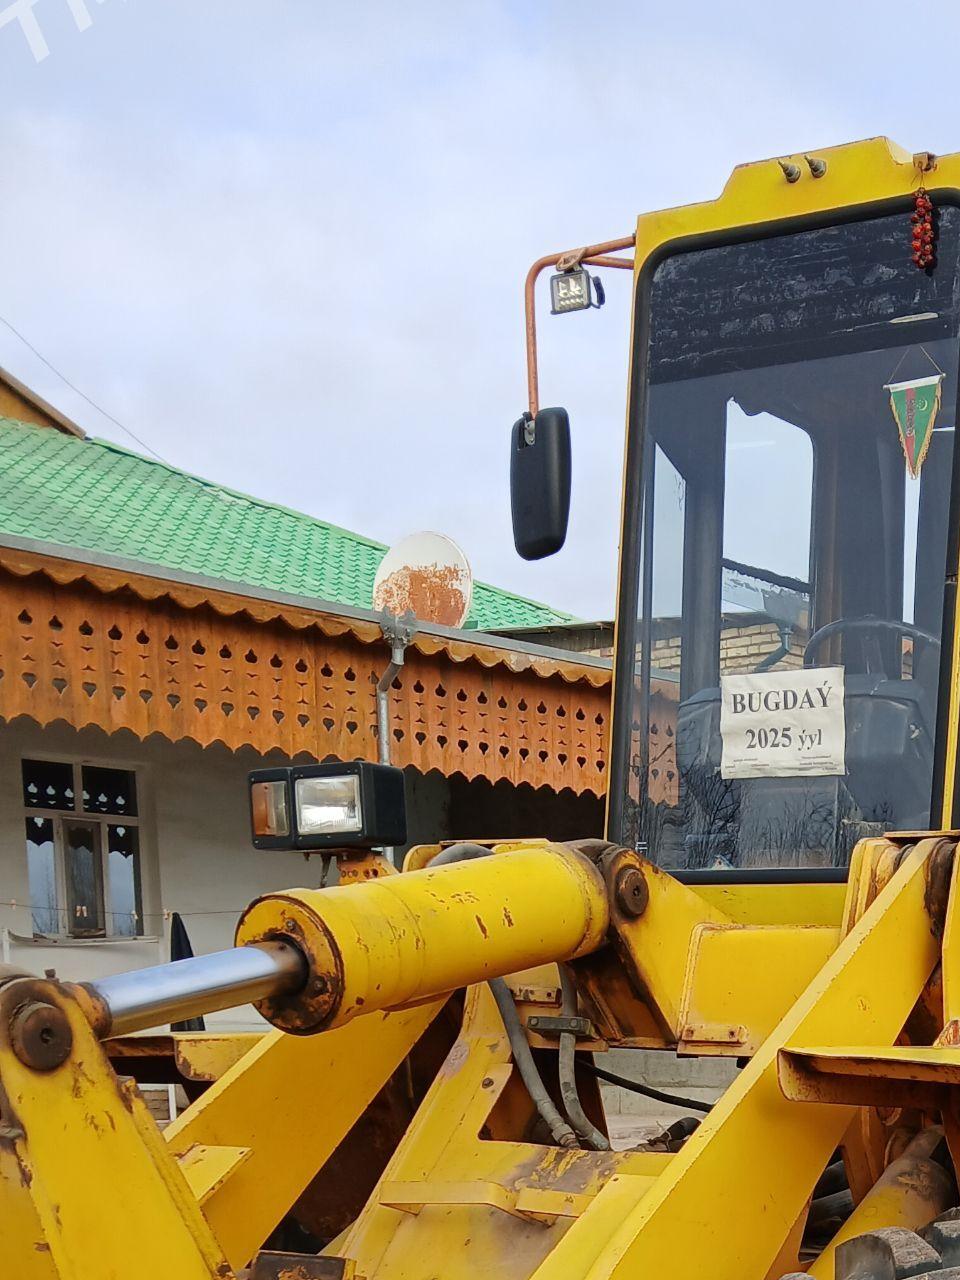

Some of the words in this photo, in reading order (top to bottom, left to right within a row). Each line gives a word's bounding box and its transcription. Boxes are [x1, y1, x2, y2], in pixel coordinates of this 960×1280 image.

[732, 680, 833, 714] BUGDAÝ
[745, 726, 792, 749] 2025
[798, 728, 822, 751] ýyl
